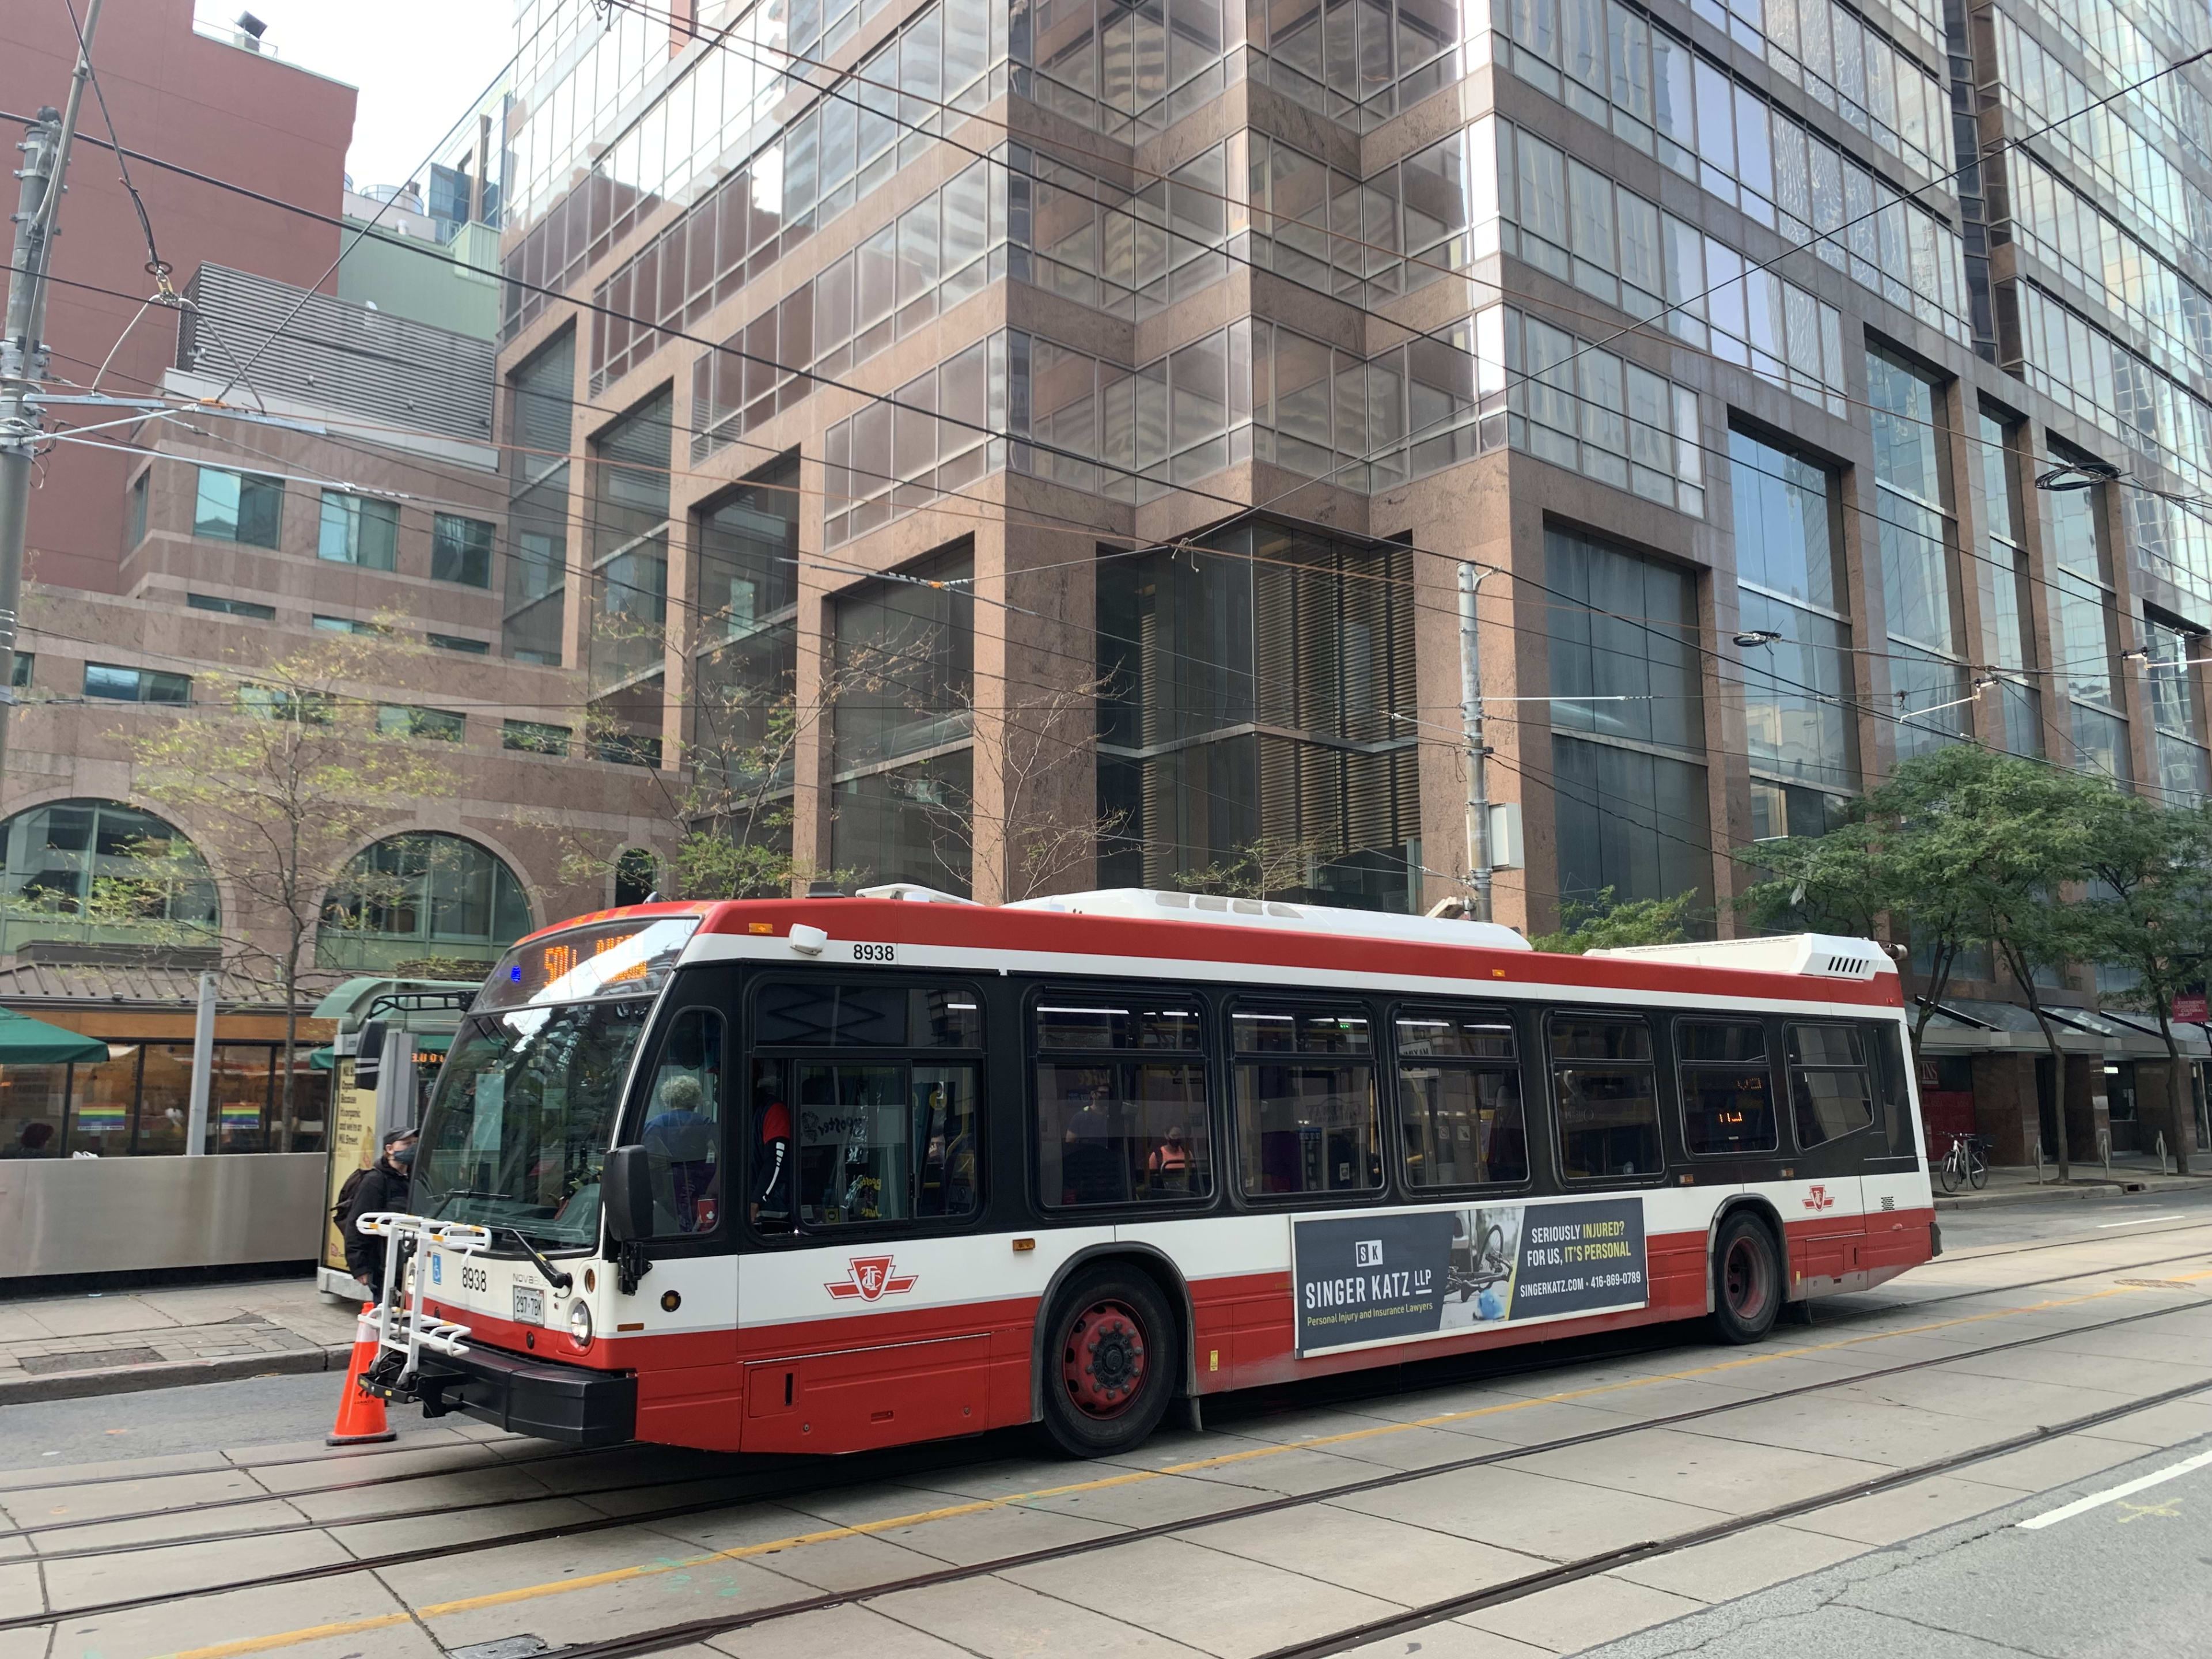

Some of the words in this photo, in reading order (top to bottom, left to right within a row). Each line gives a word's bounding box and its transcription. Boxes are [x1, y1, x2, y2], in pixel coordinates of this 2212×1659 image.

[854, 944, 894, 961] 8938
[1532, 1224, 1581, 1244] SERIOUSLY
[1583, 1221, 1625, 1238] INJURED?
[1527, 1249, 1546, 1267] FOR
[1547, 1248, 1563, 1266] US,
[1565, 1245, 1583, 1263] IT'S
[1584, 1241, 1631, 1261] PERSONAL
[463, 1266, 487, 1292] 8938
[1305, 1277, 1366, 1309] SINGER
[1372, 1271, 1410, 1300] KATZ
[1414, 1269, 1431, 1286] LLP
[1520, 1278, 1584, 1297] SINGERKATZ.COM
[1590, 1271, 1641, 1289] 416-869-0789
[1307, 1313, 1338, 1327] Personal
[1339, 1312, 1358, 1324] Injury
[1359, 1309, 1372, 1319] and
[1373, 1305, 1404, 1317] Insurance
[1406, 1302, 1433, 1314] Lawyers
